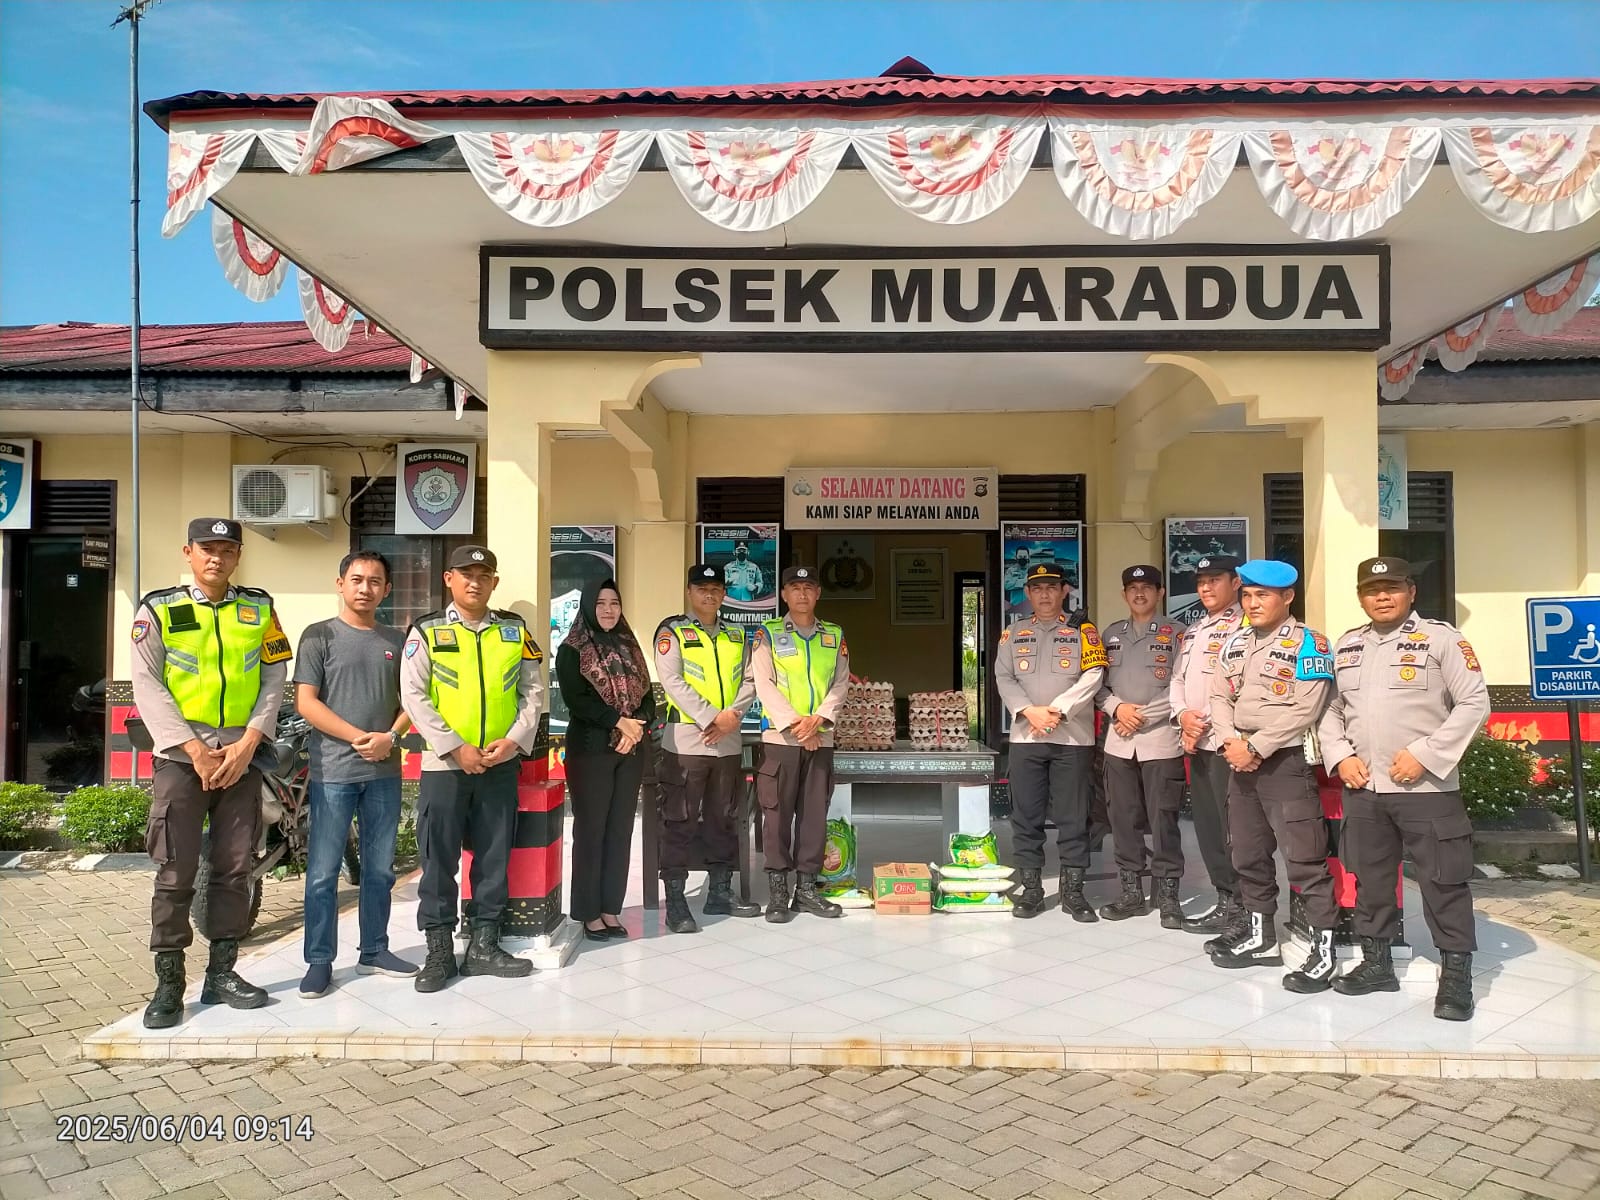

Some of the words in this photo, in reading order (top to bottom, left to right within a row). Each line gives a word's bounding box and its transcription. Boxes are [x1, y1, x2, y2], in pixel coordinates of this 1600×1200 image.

[509, 266, 841, 323] POLSEK
[871, 265, 1363, 323] MUARADUA
[408, 453, 432, 463] KORPS
[433, 453, 465, 464] SABHARA
[820, 477, 895, 498] SELAMAT
[899, 477, 966, 498] DATANG
[806, 505, 839, 519] KAMI
[843, 505, 872, 519] SIAP
[877, 505, 941, 519] MELAYANI
[945, 506, 980, 520] ANDA
[1028, 527, 1078, 535] PRESISI
[1185, 609, 1207, 619] ROA
[1533, 604, 1574, 652] P
[1149, 644, 1173, 652] POLRI
[1396, 643, 1430, 651] POLRI
[1551, 670, 1593, 681] PARKIR
[1540, 680, 1600, 692] DISABILITA
